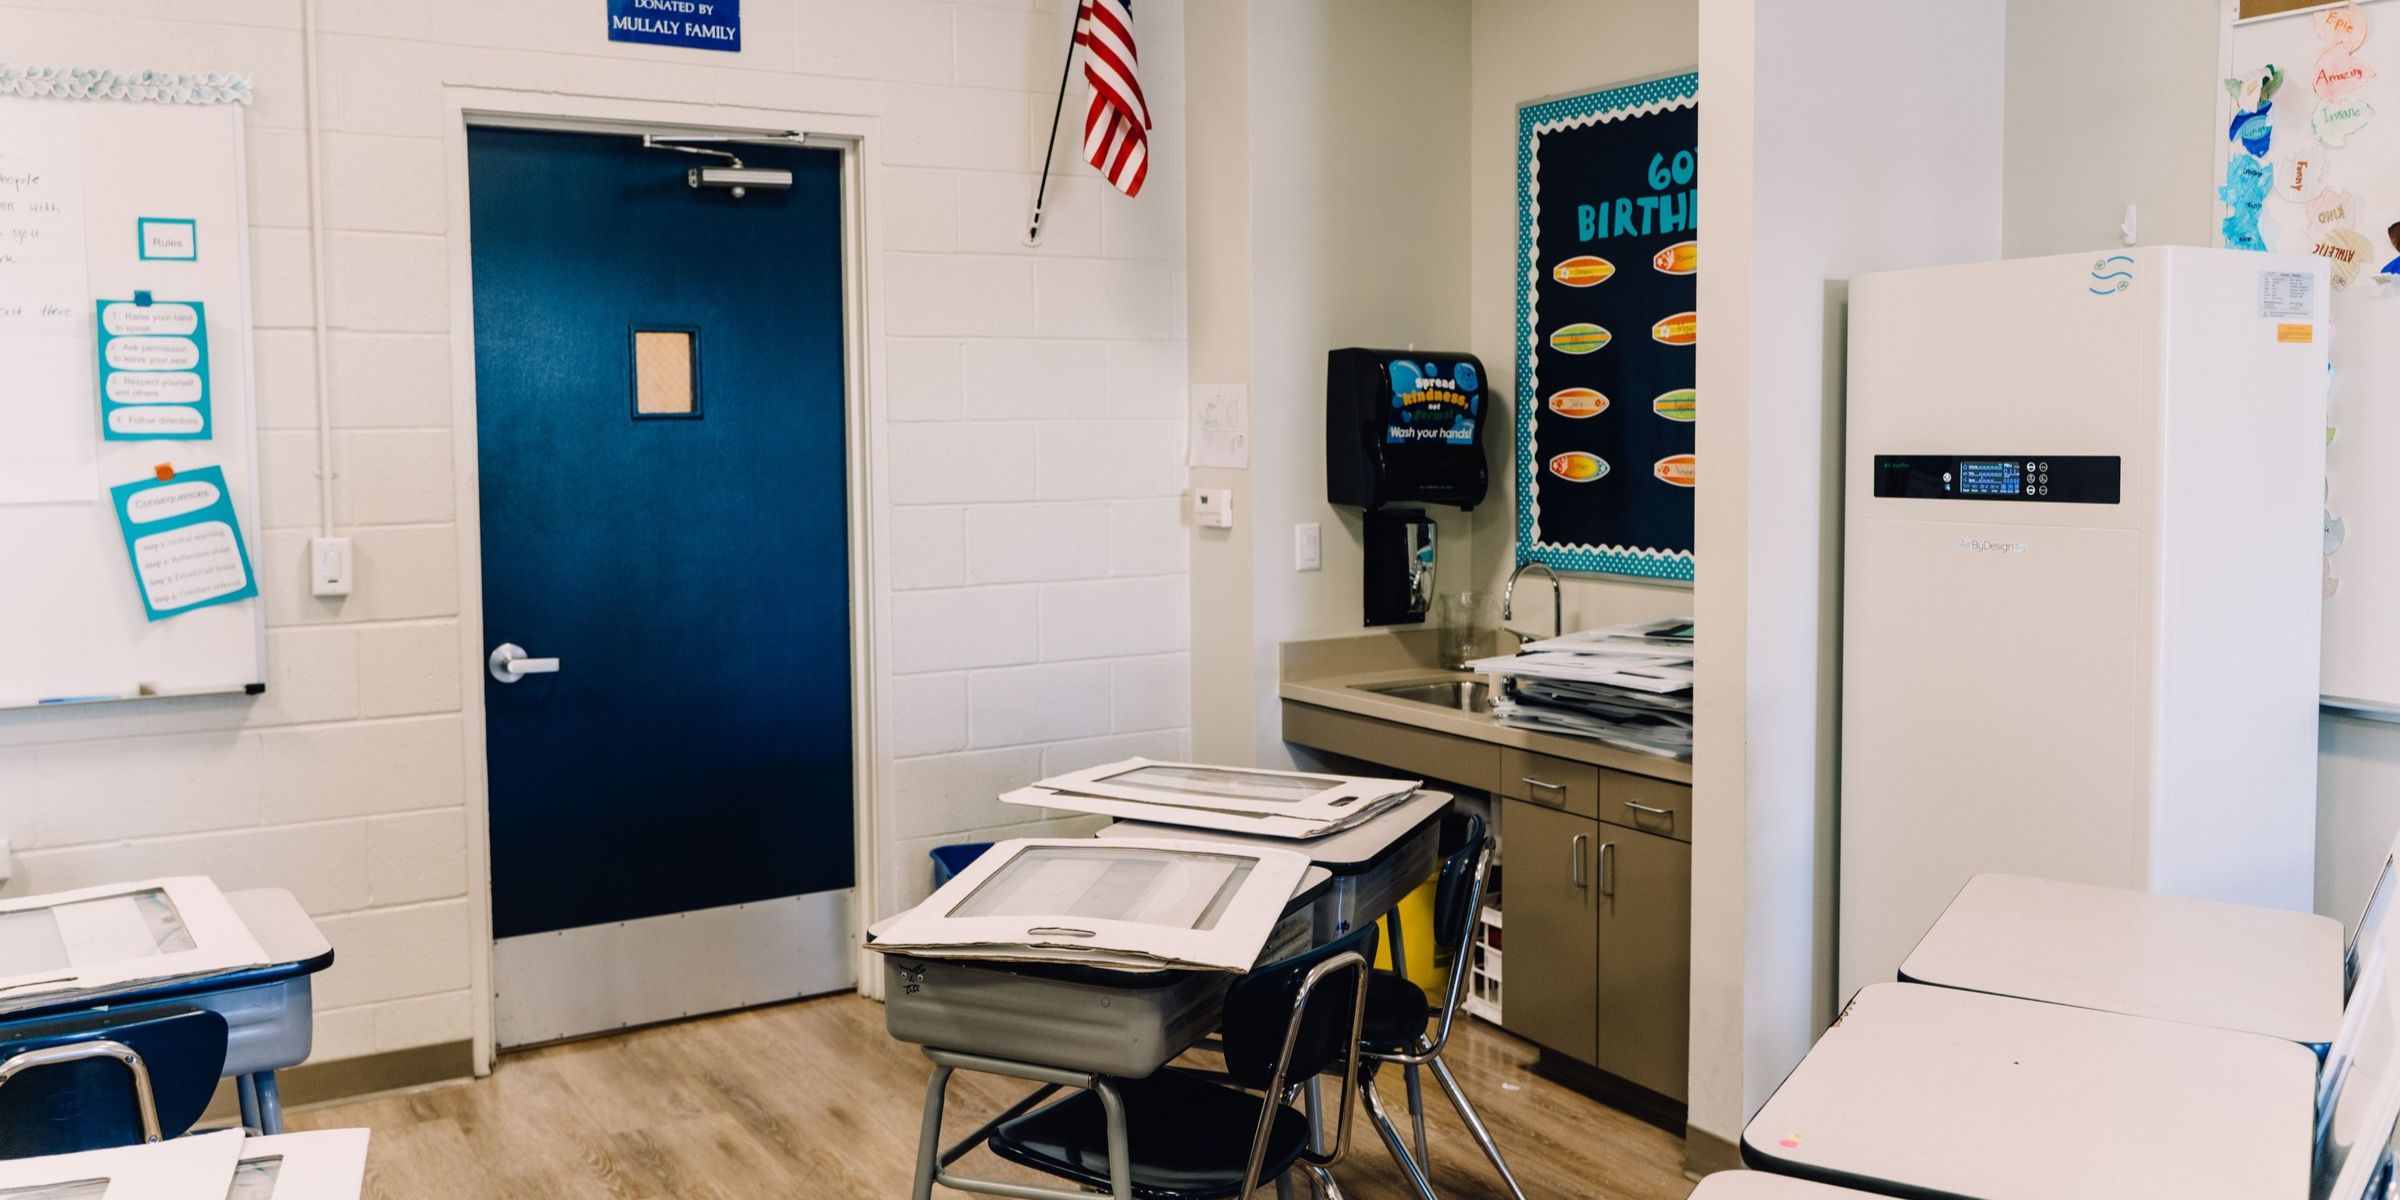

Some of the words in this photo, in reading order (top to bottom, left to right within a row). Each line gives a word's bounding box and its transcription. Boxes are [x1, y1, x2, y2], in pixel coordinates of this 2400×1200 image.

[635, 0, 695, 13] DONATED
[699, 4, 714, 15] BY
[613, 15, 680, 36] MULLALY
[685, 22, 736, 41] FAMILY
[1648, 147, 1697, 190] 60
[2318, 204, 2346, 224] KIND
[13, 228, 39, 245] you
[152, 237, 183, 248] Rules
[2312, 244, 2356, 263] ATHLETIC
[153, 315, 171, 323] your
[125, 324, 151, 332] speak
[141, 344, 187, 354] permission
[123, 355, 146, 363] leave
[149, 357, 168, 365] your
[124, 377, 159, 387] Respect
[162, 379, 194, 388] yourself
[115, 389, 130, 397] and
[132, 389, 159, 397] others
[1402, 388, 1469, 410] kindness,
[129, 416, 156, 425] Follow
[159, 417, 199, 426] directions
[1390, 427, 1415, 439] Wash
[1417, 429, 1439, 440] your
[1439, 427, 1472, 439] hands!
[135, 489, 210, 509] Consequences
[1959, 539, 2014, 553] AirByDesign
